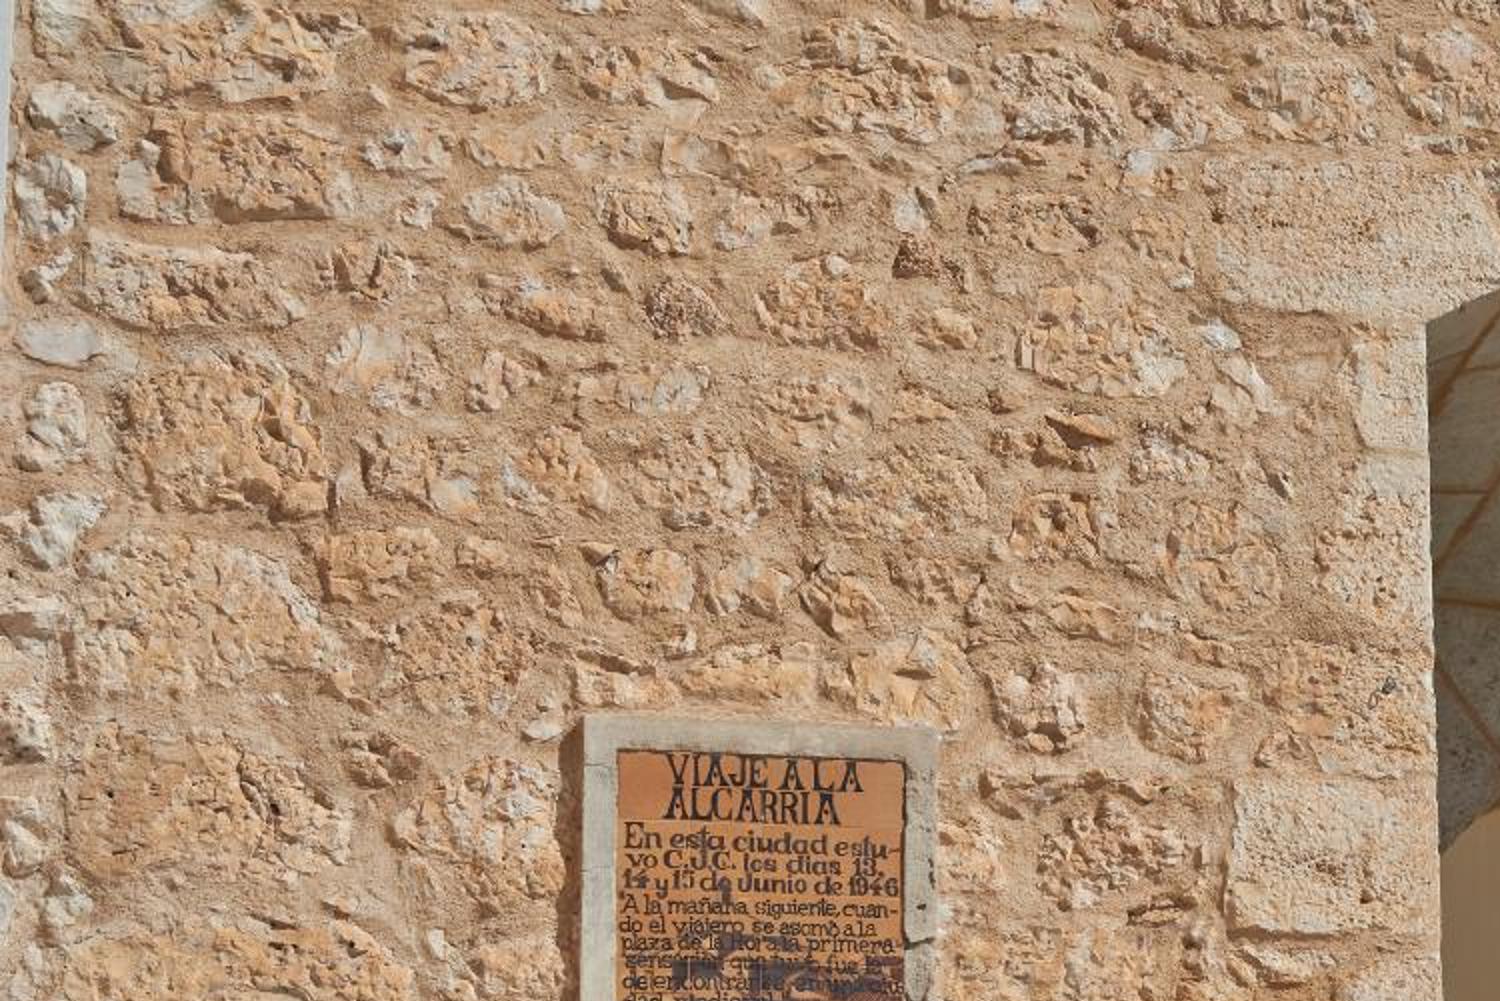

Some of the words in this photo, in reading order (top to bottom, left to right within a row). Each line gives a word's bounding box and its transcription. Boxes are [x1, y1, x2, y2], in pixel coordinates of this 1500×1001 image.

[663, 752, 769, 788] VIAJE
[778, 758, 805, 791] A
[812, 759, 864, 792] LA
[663, 785, 841, 825] ALCARRIA
[624, 822, 662, 849] En
[670, 826, 725, 851] esta
[732, 831, 828, 856] ciudad
[626, 854, 658, 869] vo
[744, 854, 776, 873] los
[623, 869, 649, 889] 14
[655, 879, 668, 899] y
[673, 870, 694, 890] 15
[699, 872, 731, 893] de
[737, 873, 807, 895] Junio
[813, 875, 842, 895] de
[849, 877, 899, 897] 1946
[644, 894, 661, 916] la
[668, 897, 749, 916] mañana
[619, 916, 643, 933] do
[649, 916, 667, 933] el
[672, 917, 745, 935] viajero
[752, 920, 774, 934] se
[622, 932, 673, 957] plaza
[678, 933, 702, 951] de
[807, 937, 894, 960] primera
[622, 970, 648, 990] de
